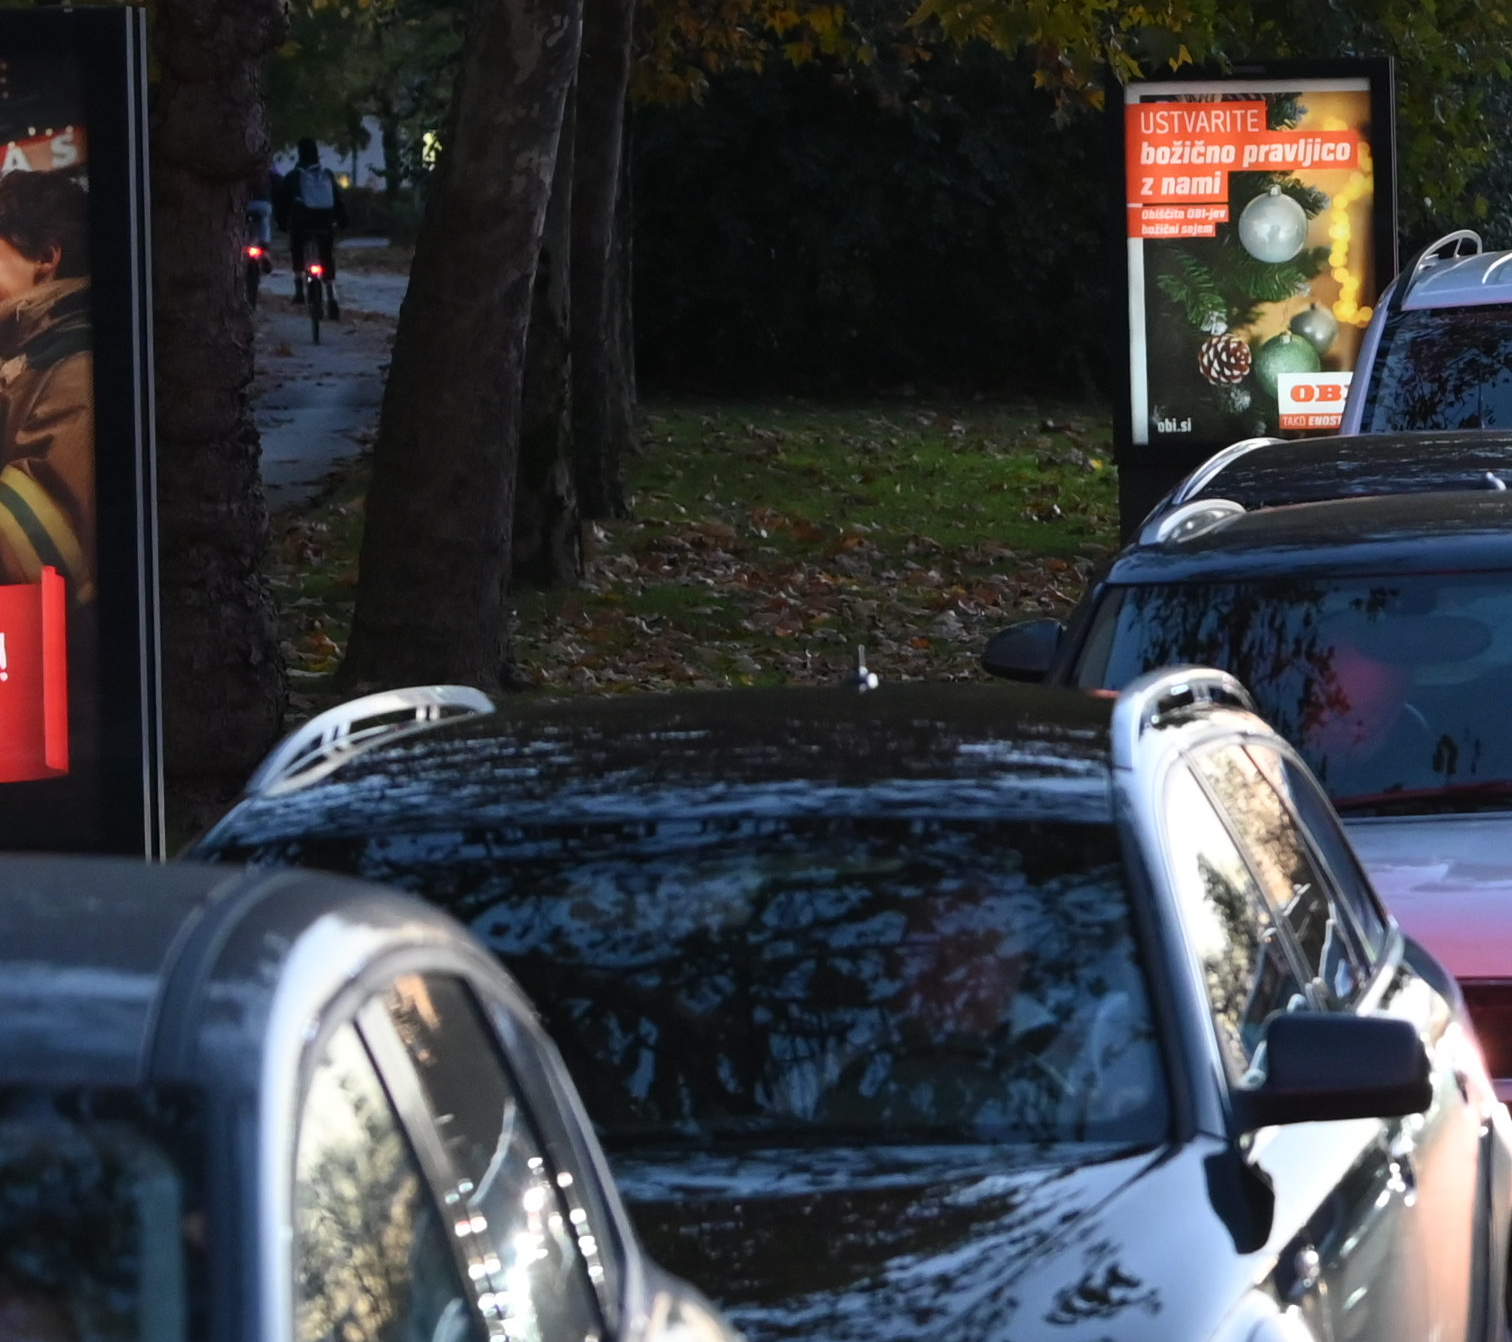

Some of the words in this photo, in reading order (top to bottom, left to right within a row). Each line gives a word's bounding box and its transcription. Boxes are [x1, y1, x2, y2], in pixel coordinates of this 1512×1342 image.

[1140, 109, 1260, 134] USTVARITE
[1140, 139, 1236, 165] božično
[1242, 137, 1351, 168] pravljico
[1140, 176, 1155, 196] z
[1160, 170, 1222, 196] nami
[1141, 222, 1180, 236] božični
[1180, 224, 1214, 237] sejem
[1290, 384, 1349, 402] OB
[1157, 416, 1192, 433] obi.si
[1282, 415, 1306, 428] TAKO
[1307, 414, 1342, 427] ENOST
